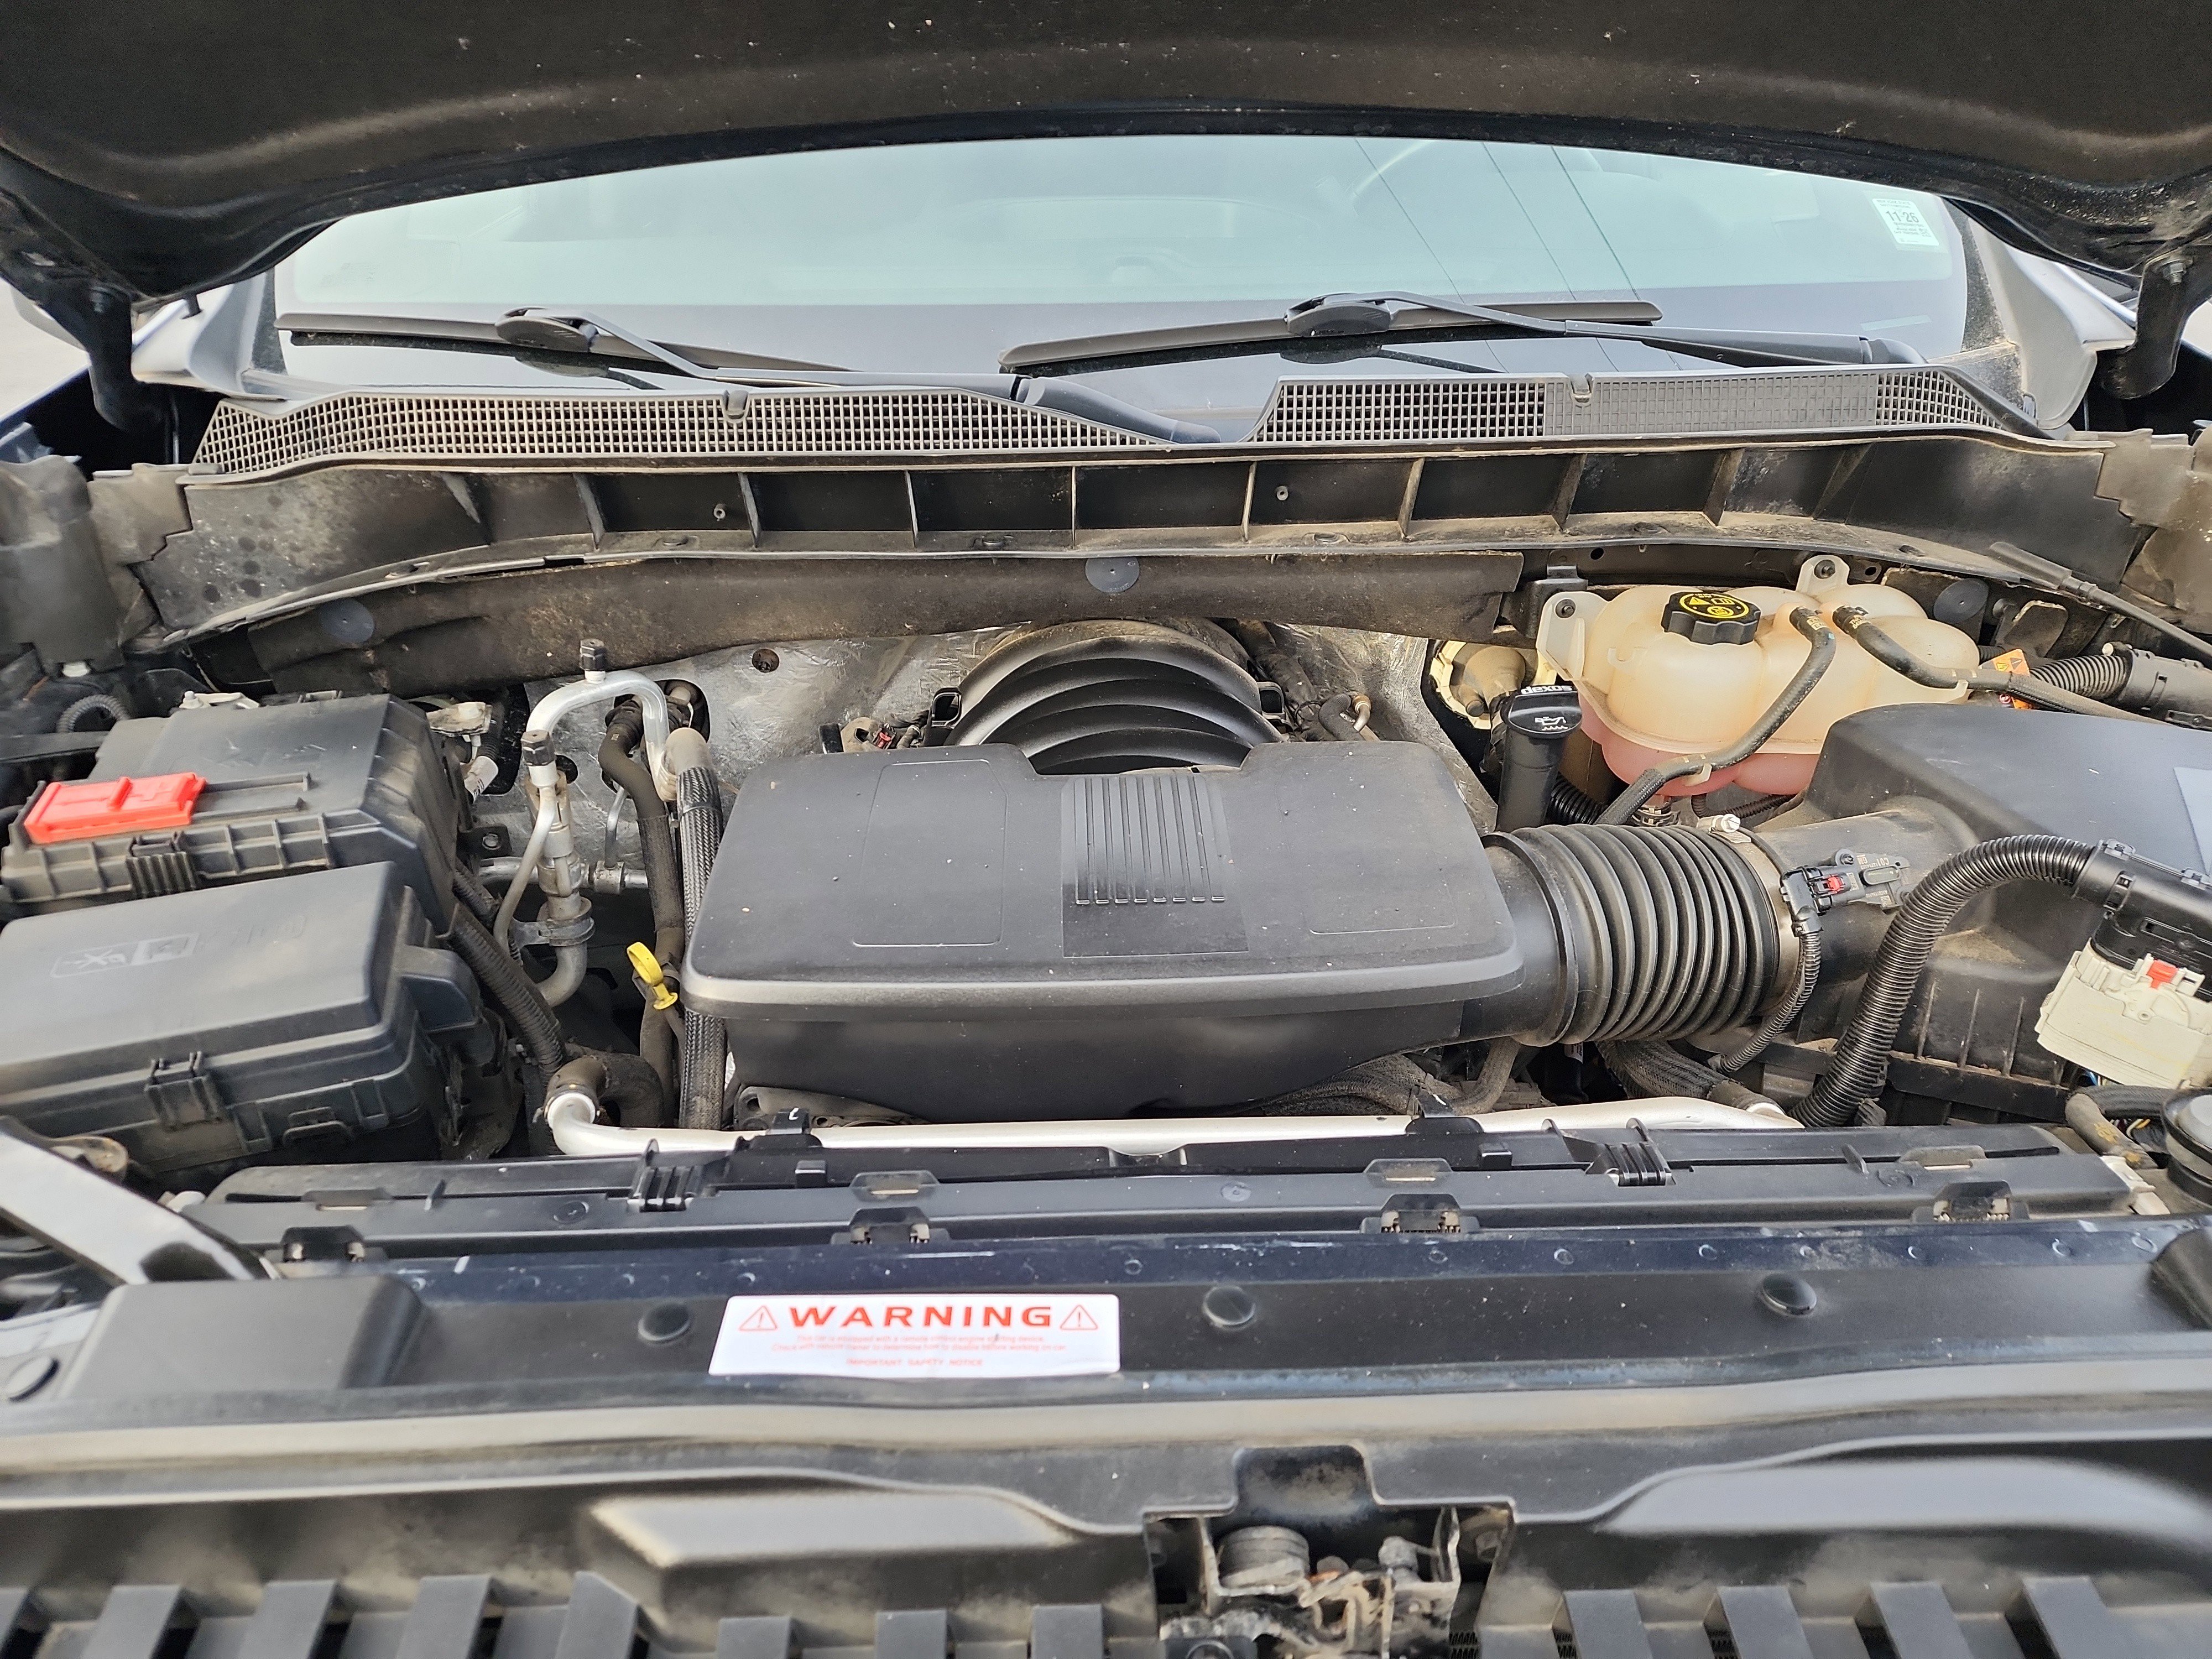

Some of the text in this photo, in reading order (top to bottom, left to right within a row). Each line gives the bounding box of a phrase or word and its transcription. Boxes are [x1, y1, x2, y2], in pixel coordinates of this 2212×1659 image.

[1521, 686, 1573, 695] dexos
[790, 1307, 1051, 1327] WARNING
[949, 1358, 983, 1366] NOTICE
